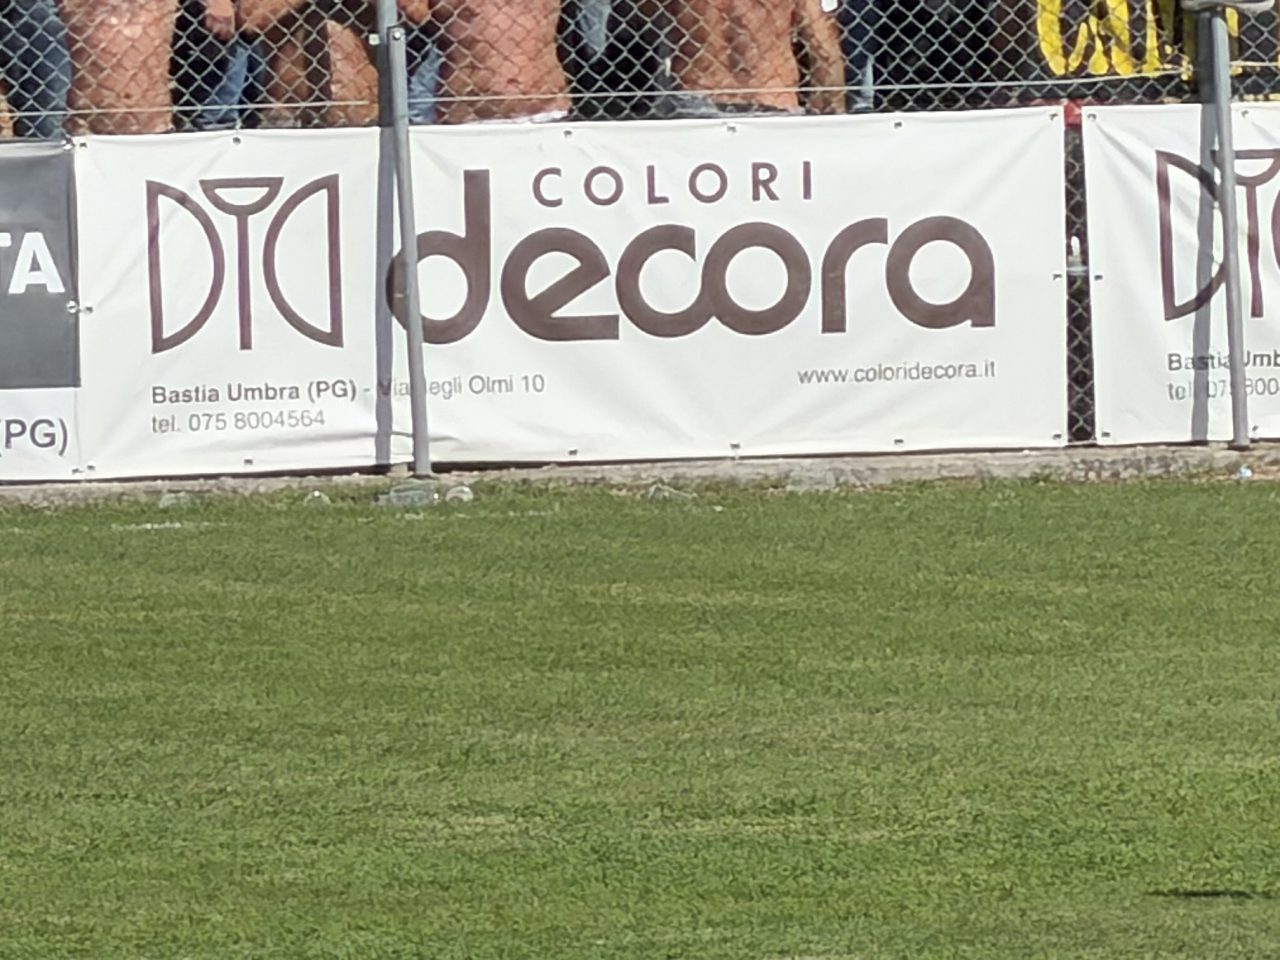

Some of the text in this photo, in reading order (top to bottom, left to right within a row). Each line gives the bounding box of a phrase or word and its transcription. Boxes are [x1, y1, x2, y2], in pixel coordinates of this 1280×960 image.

[532, 160, 813, 208] COLORI
[385, 169, 996, 345] decora
[797, 359, 995, 385] www.coloridecora.it
[151, 384, 220, 404] Bastia
[227, 382, 300, 402] Umbra
[307, 378, 358, 404] (PG)
[424, 375, 463, 400] egli
[468, 374, 514, 395] Olmi
[521, 373, 546, 393] 10
[151, 409, 326, 433] tel. 075 8004564
